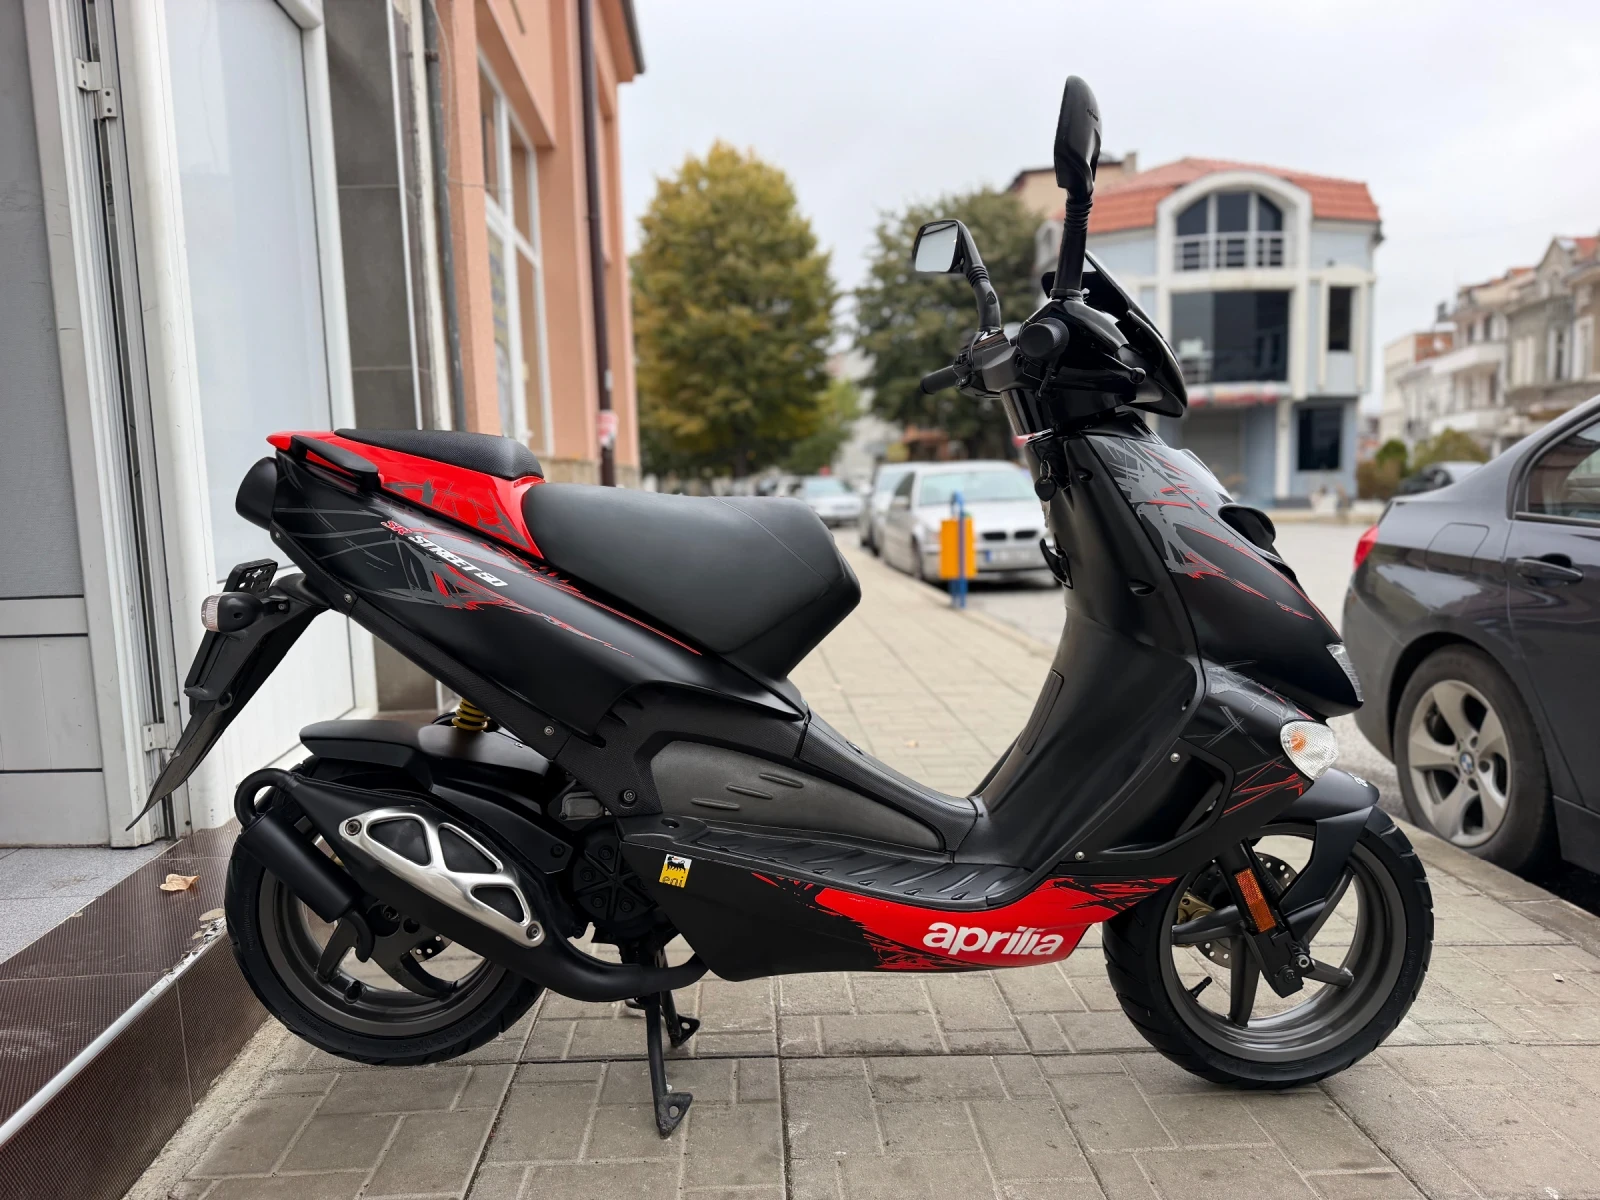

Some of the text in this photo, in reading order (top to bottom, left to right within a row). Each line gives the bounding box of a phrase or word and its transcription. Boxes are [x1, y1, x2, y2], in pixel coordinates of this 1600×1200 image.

[408, 535, 482, 572] STREET
[661, 875, 684, 887] eni
[922, 921, 1064, 956] aprilia
